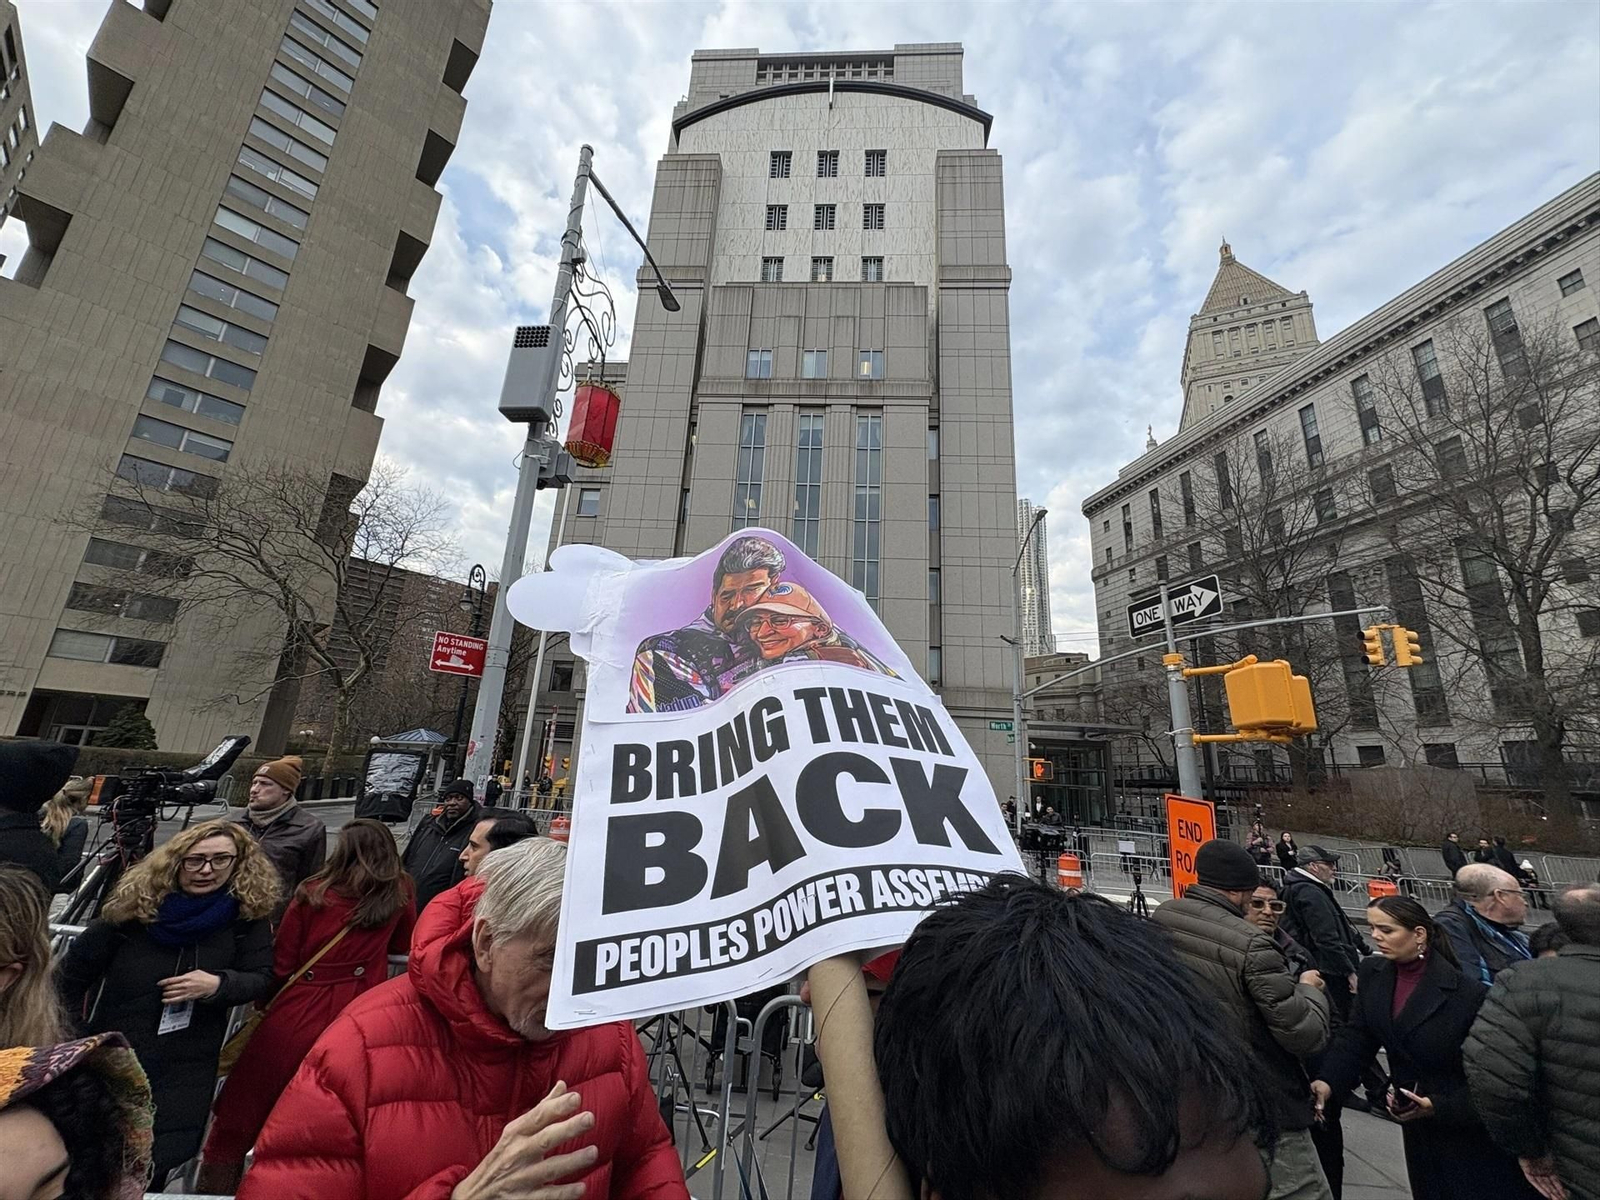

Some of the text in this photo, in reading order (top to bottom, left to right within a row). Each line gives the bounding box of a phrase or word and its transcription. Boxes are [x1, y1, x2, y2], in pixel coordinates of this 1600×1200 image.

[1135, 591, 1204, 625] ONE WAY
[437, 644, 467, 657] Anytime
[438, 636, 484, 651] NO STANDING
[610, 687, 956, 804] BRING THEM
[601, 751, 1003, 915] BACK
[1177, 819, 1203, 843] END
[1175, 850, 1197, 875] RO
[595, 919, 749, 986] PEOPLES
[753, 873, 866, 952] POWER
